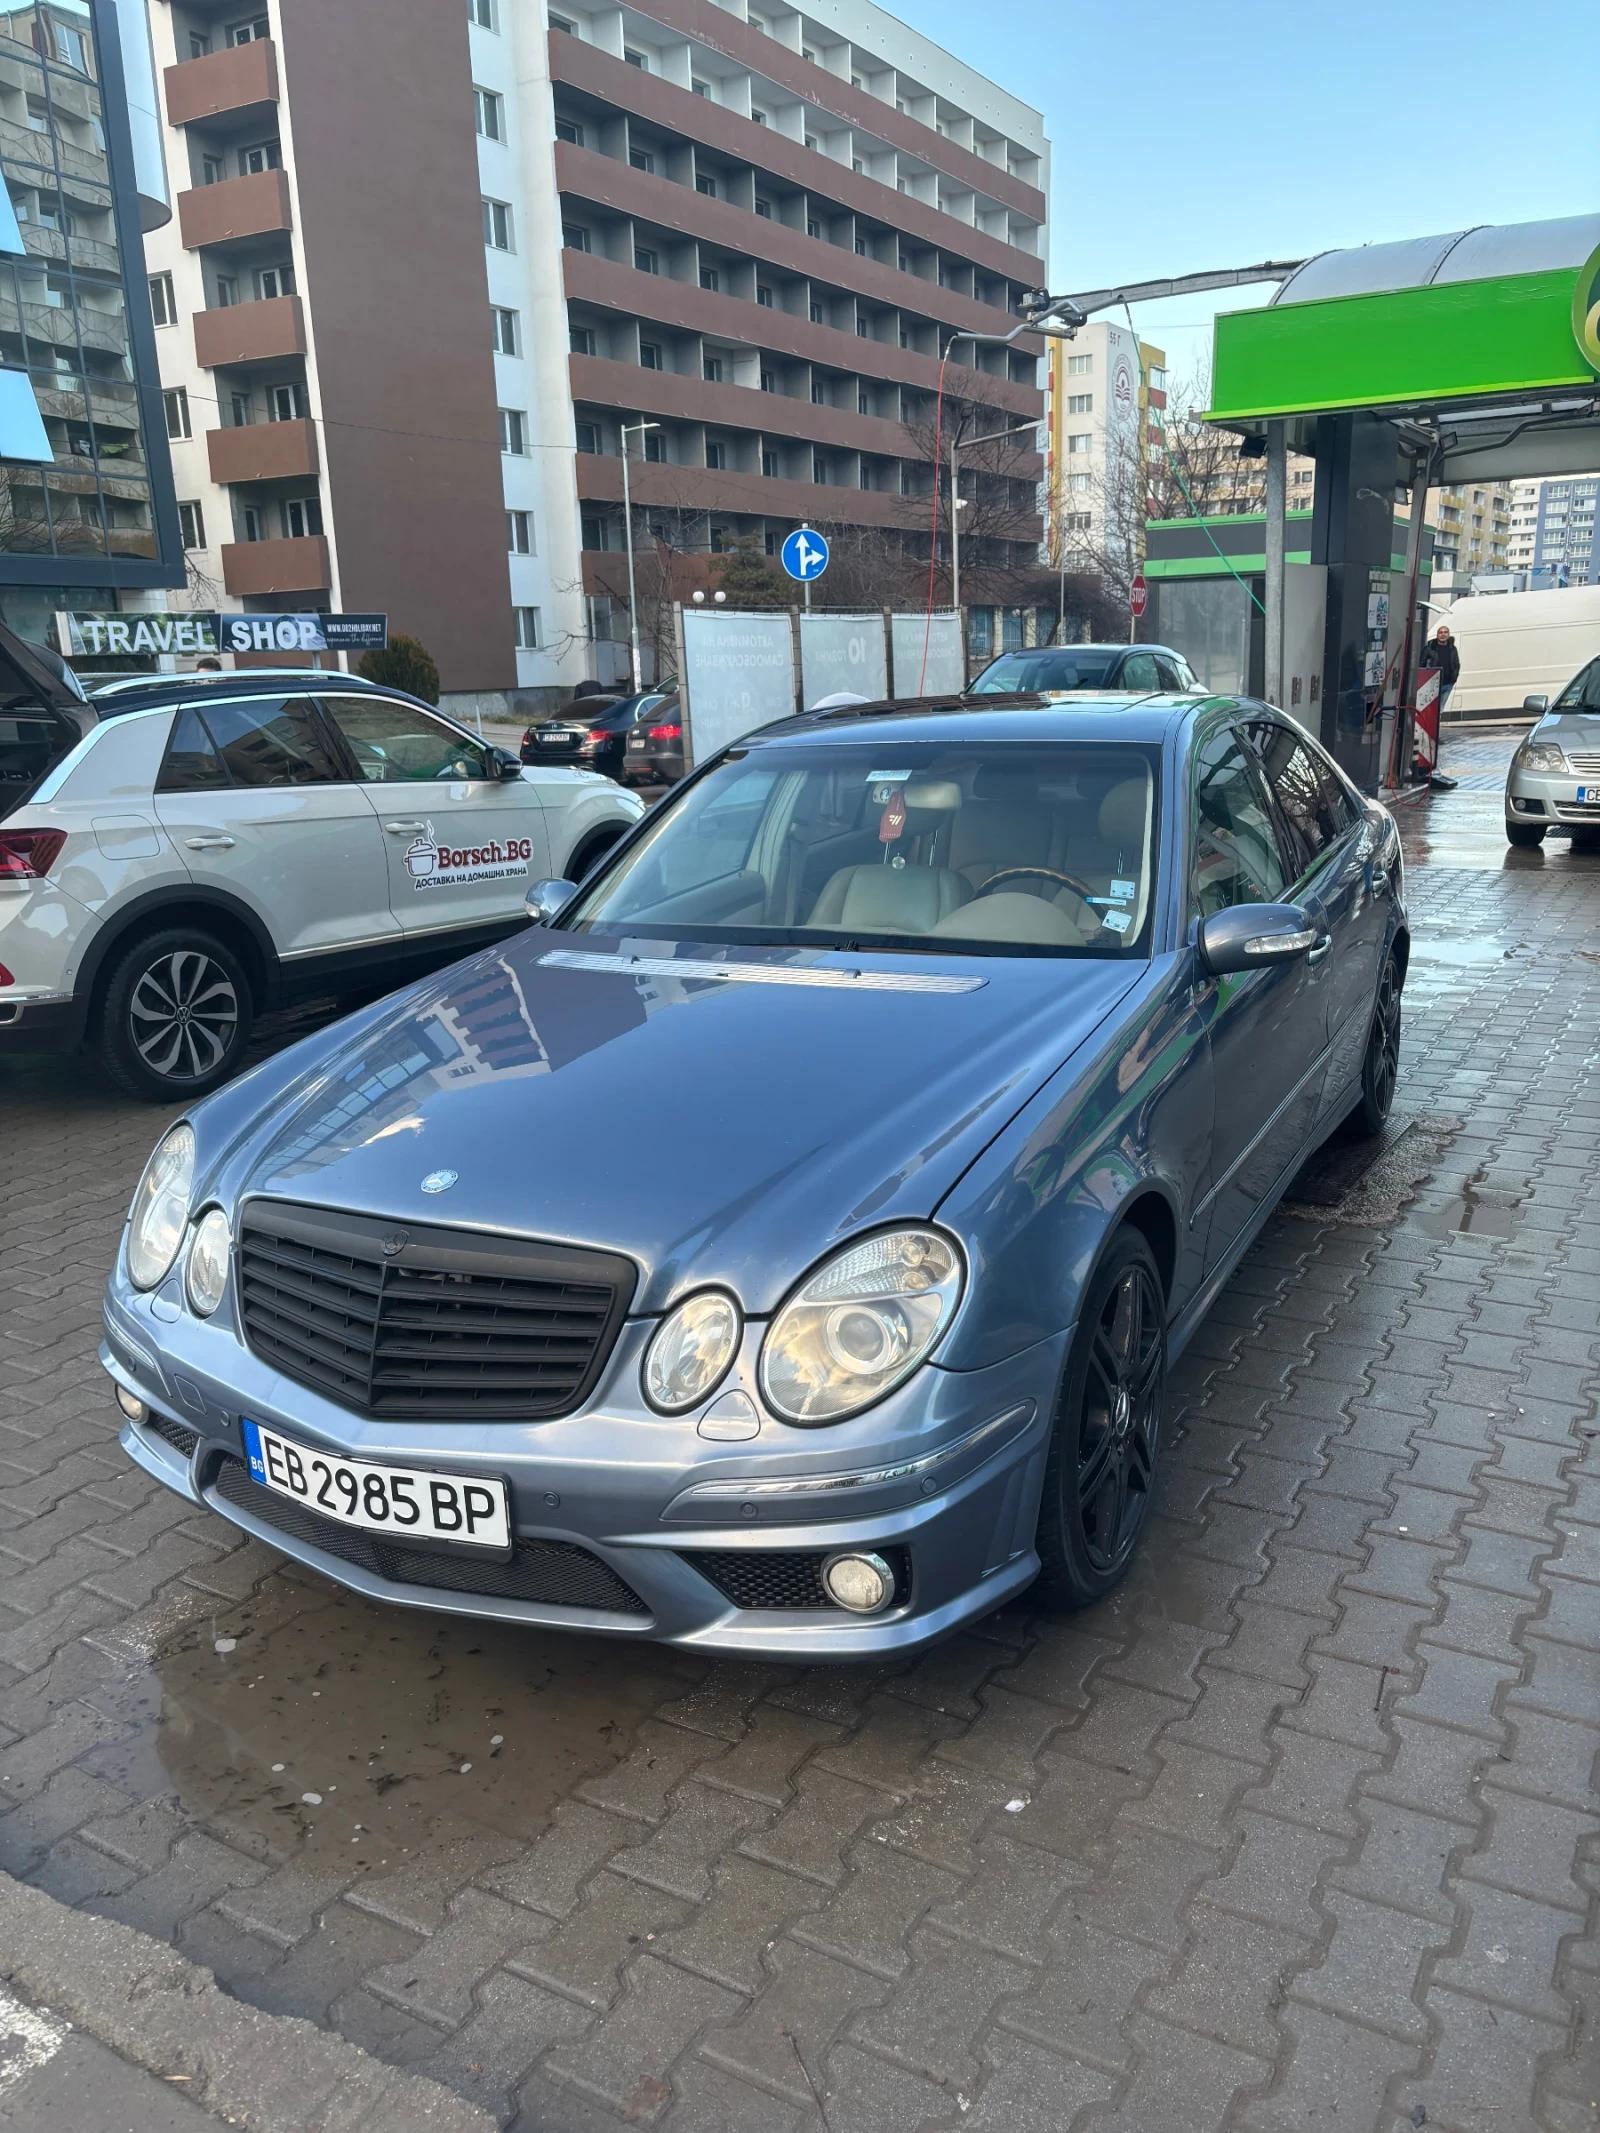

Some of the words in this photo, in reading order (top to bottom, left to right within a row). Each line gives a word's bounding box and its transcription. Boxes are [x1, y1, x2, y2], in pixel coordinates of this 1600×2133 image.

[1131, 587, 1146, 603] STOP
[83, 620, 216, 652] TRAVEL
[231, 620, 317, 651] SHOP
[437, 839, 532, 870] Borsch.BG
[415, 875, 456, 890] ДОСТАВКА
[457, 873, 467, 883] НА
[467, 869, 505, 883] ДОМАШНА
[506, 867, 527, 877] ХРАНА
[251, 1455, 264, 1473] BG
[312, 1459, 420, 1526] 2985
[429, 1481, 495, 1534] BP
